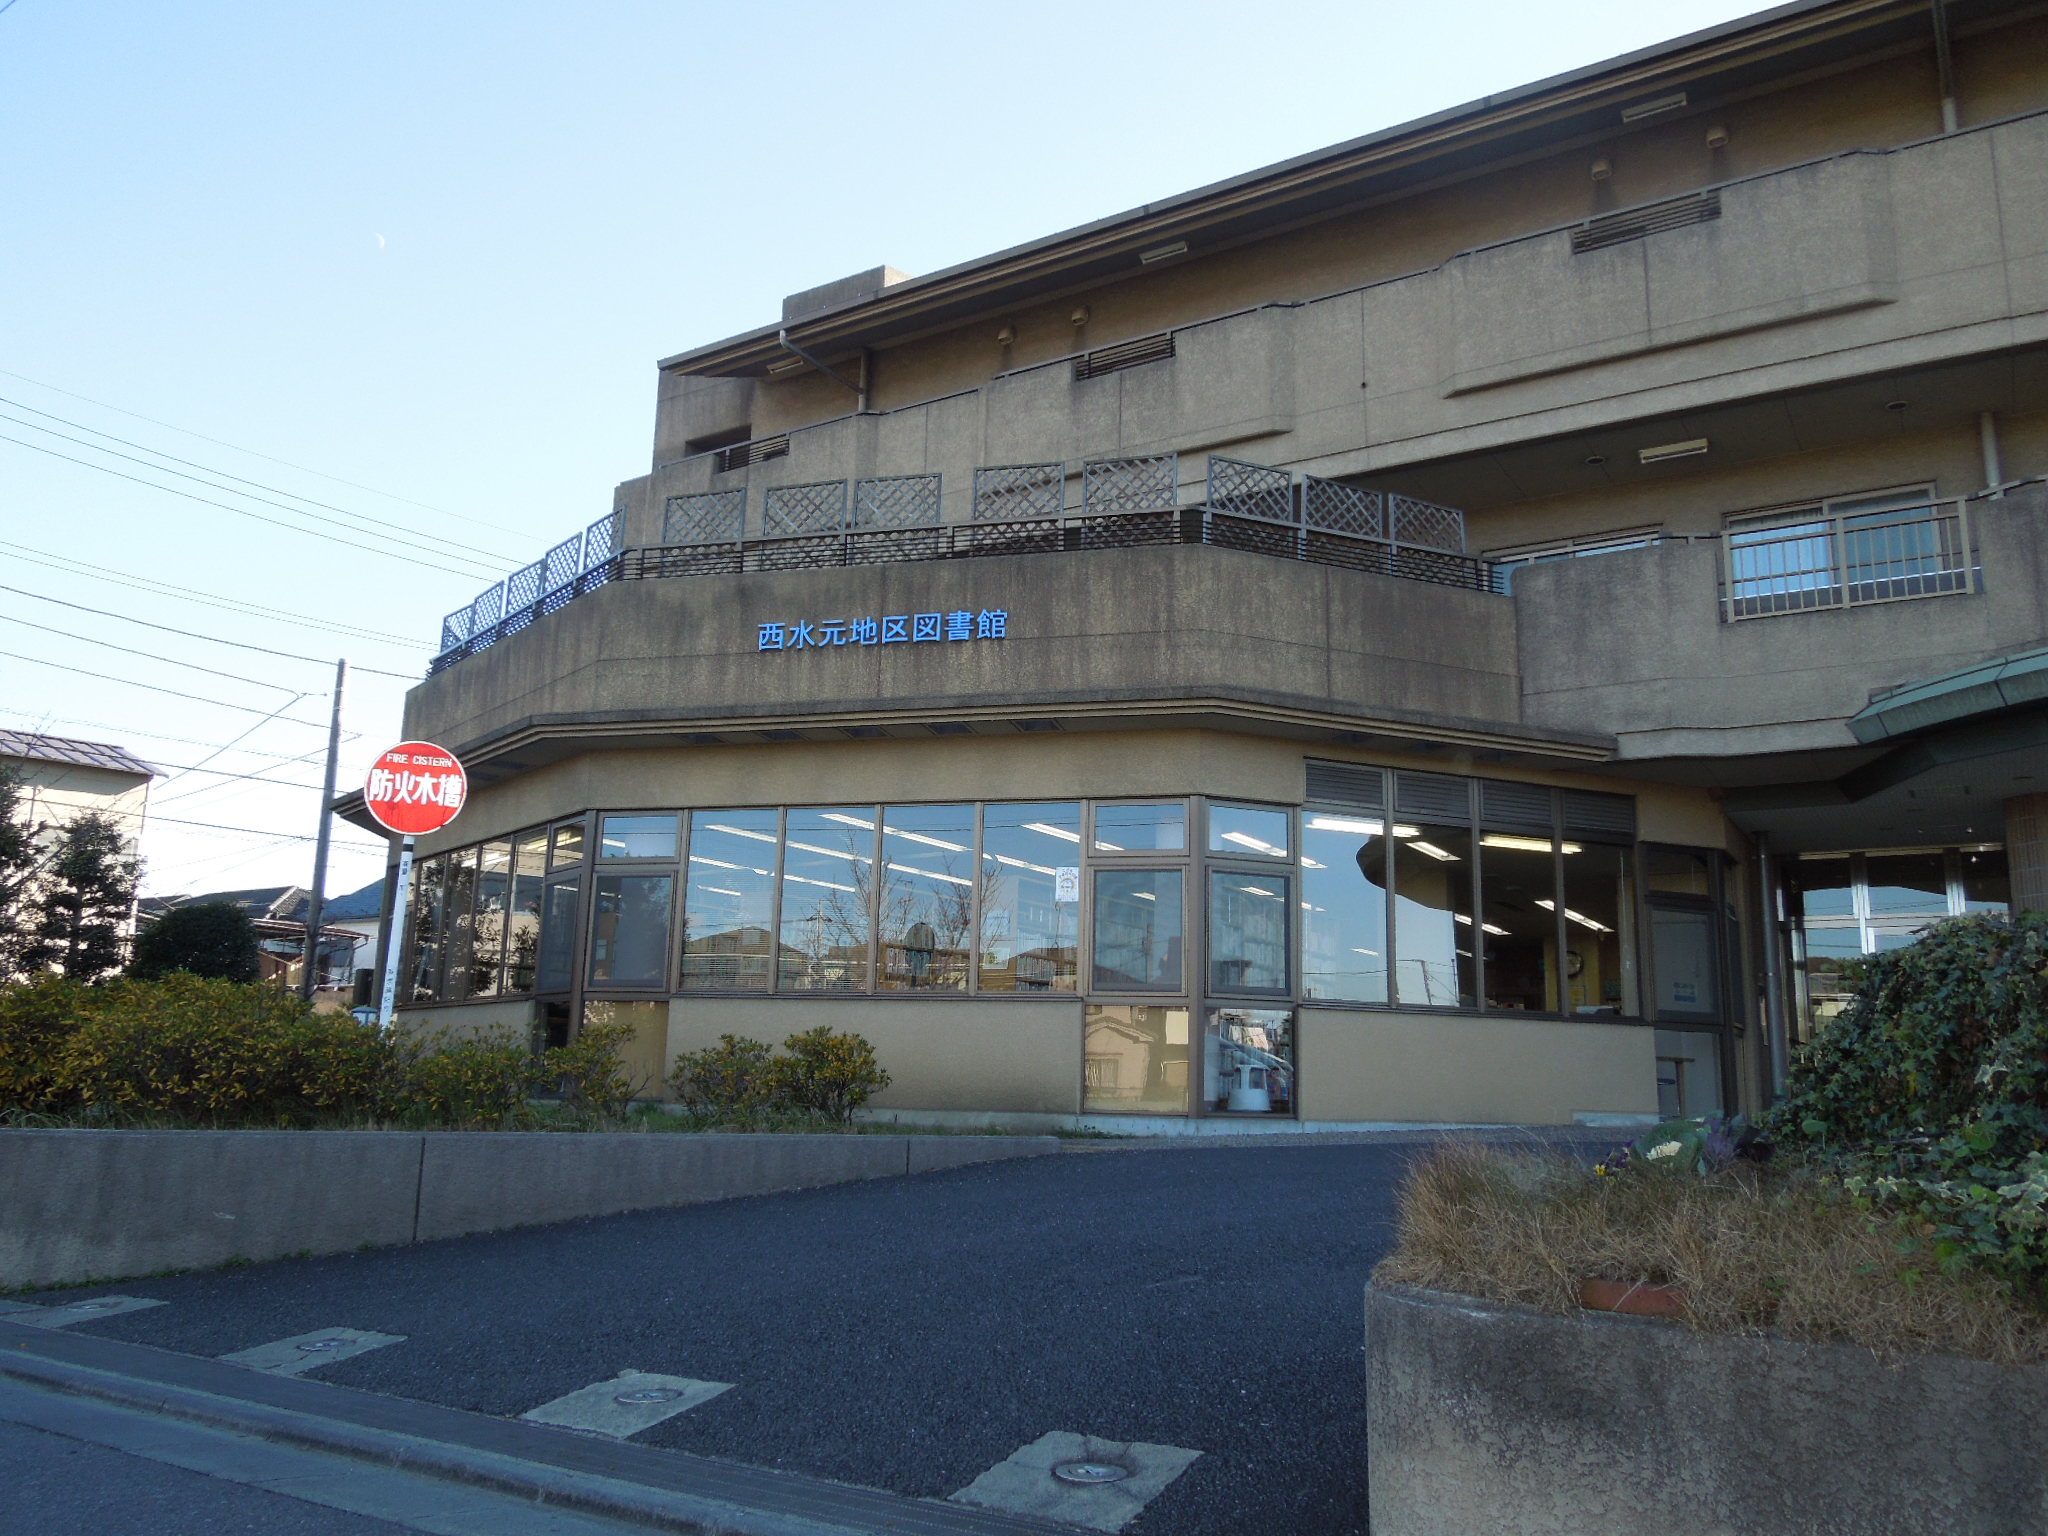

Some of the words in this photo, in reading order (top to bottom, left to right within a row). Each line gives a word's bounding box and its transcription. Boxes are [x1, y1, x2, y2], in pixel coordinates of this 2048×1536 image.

[757, 609, 1008, 650] 西水元地区図書館
[386, 753, 408, 764] FIRE
[413, 755, 453, 768] CISTERN
